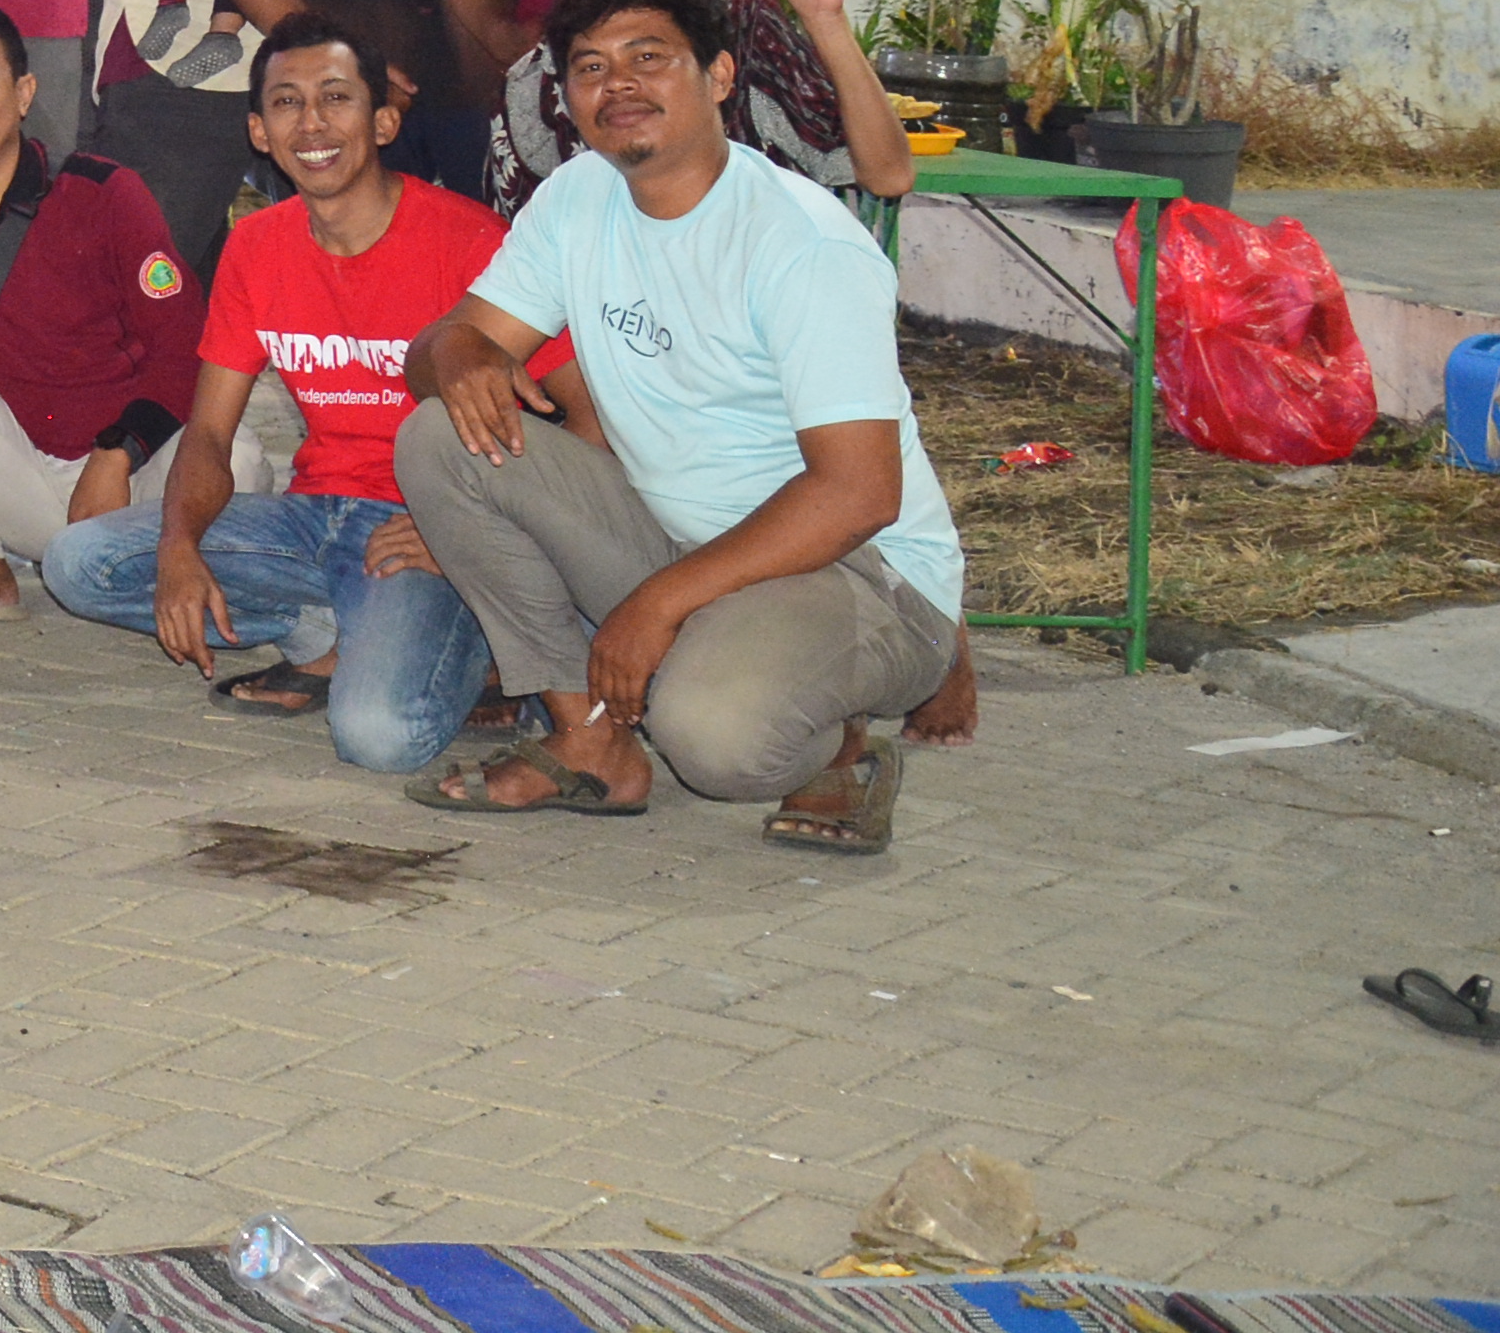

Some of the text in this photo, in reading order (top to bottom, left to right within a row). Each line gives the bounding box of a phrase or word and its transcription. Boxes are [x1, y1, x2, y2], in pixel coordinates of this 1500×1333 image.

[255, 330, 411, 377] INDONES
[296, 387, 406, 407] Independence Day
